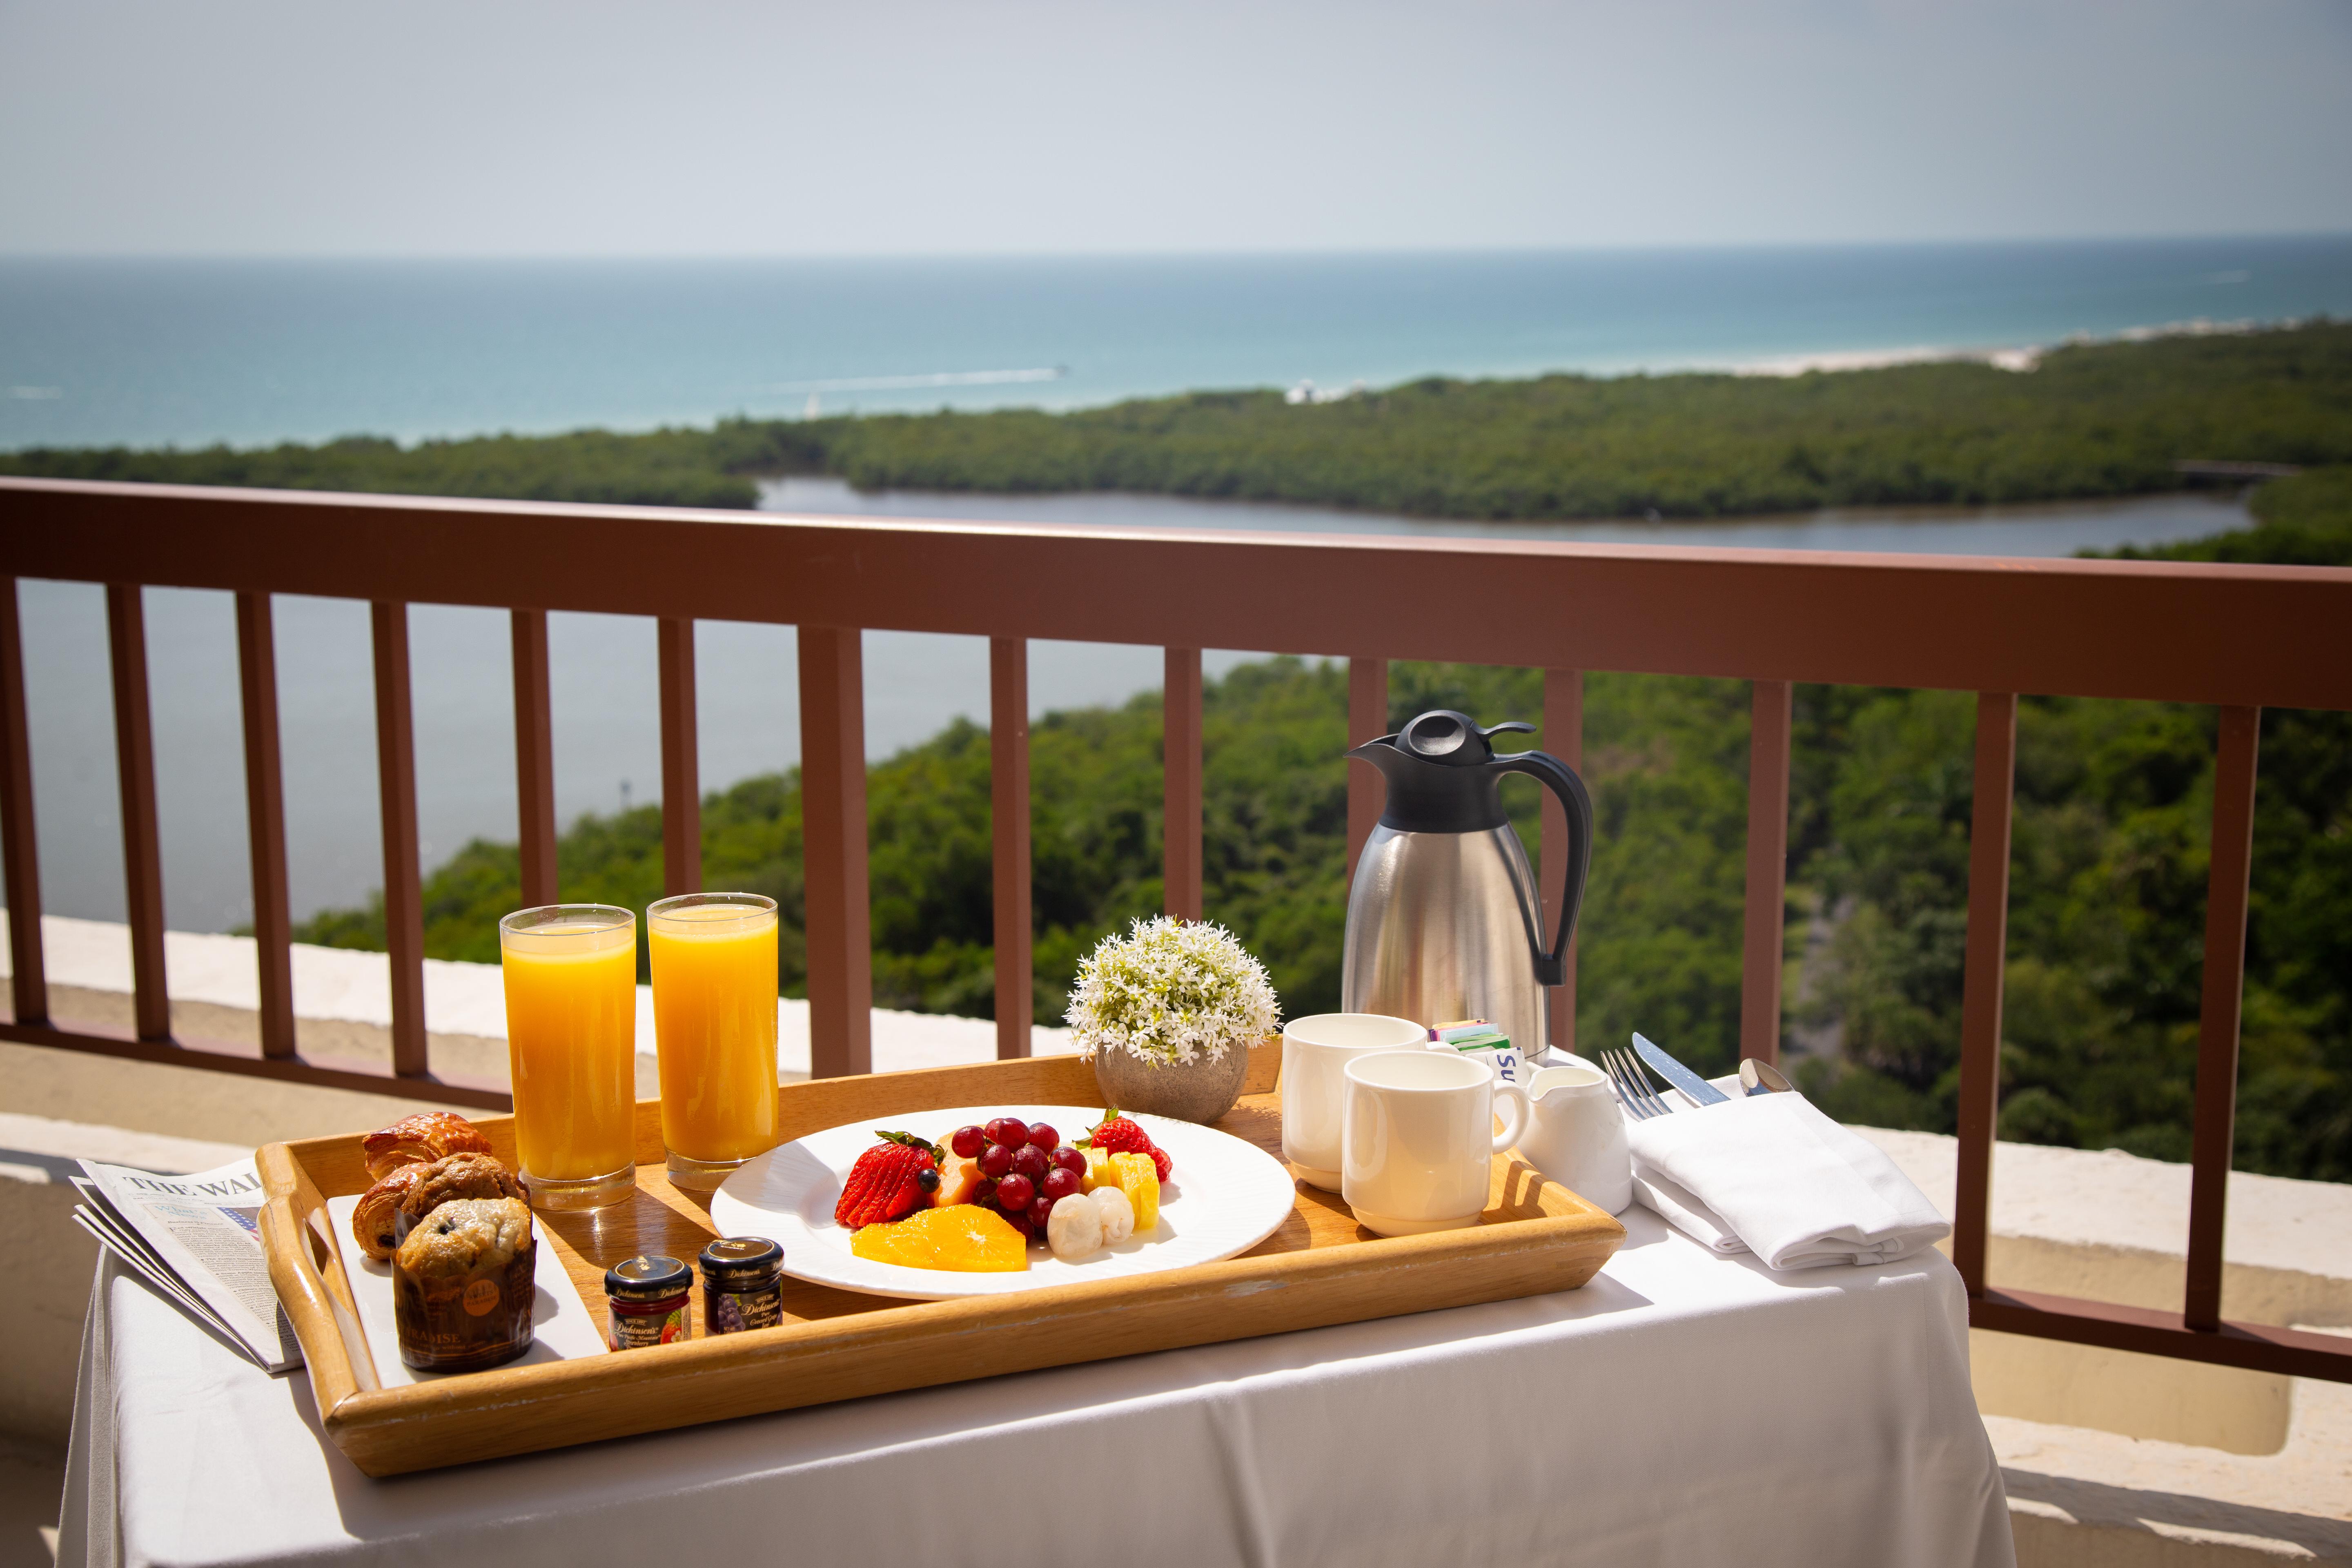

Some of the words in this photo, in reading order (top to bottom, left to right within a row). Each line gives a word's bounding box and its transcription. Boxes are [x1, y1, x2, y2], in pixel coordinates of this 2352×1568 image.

[122, 1176, 197, 1196] THE
[155, 1205, 207, 1214] What's
[741, 1298, 780, 1316] Dickinson's
[615, 1321, 657, 1335] Dickinson's
